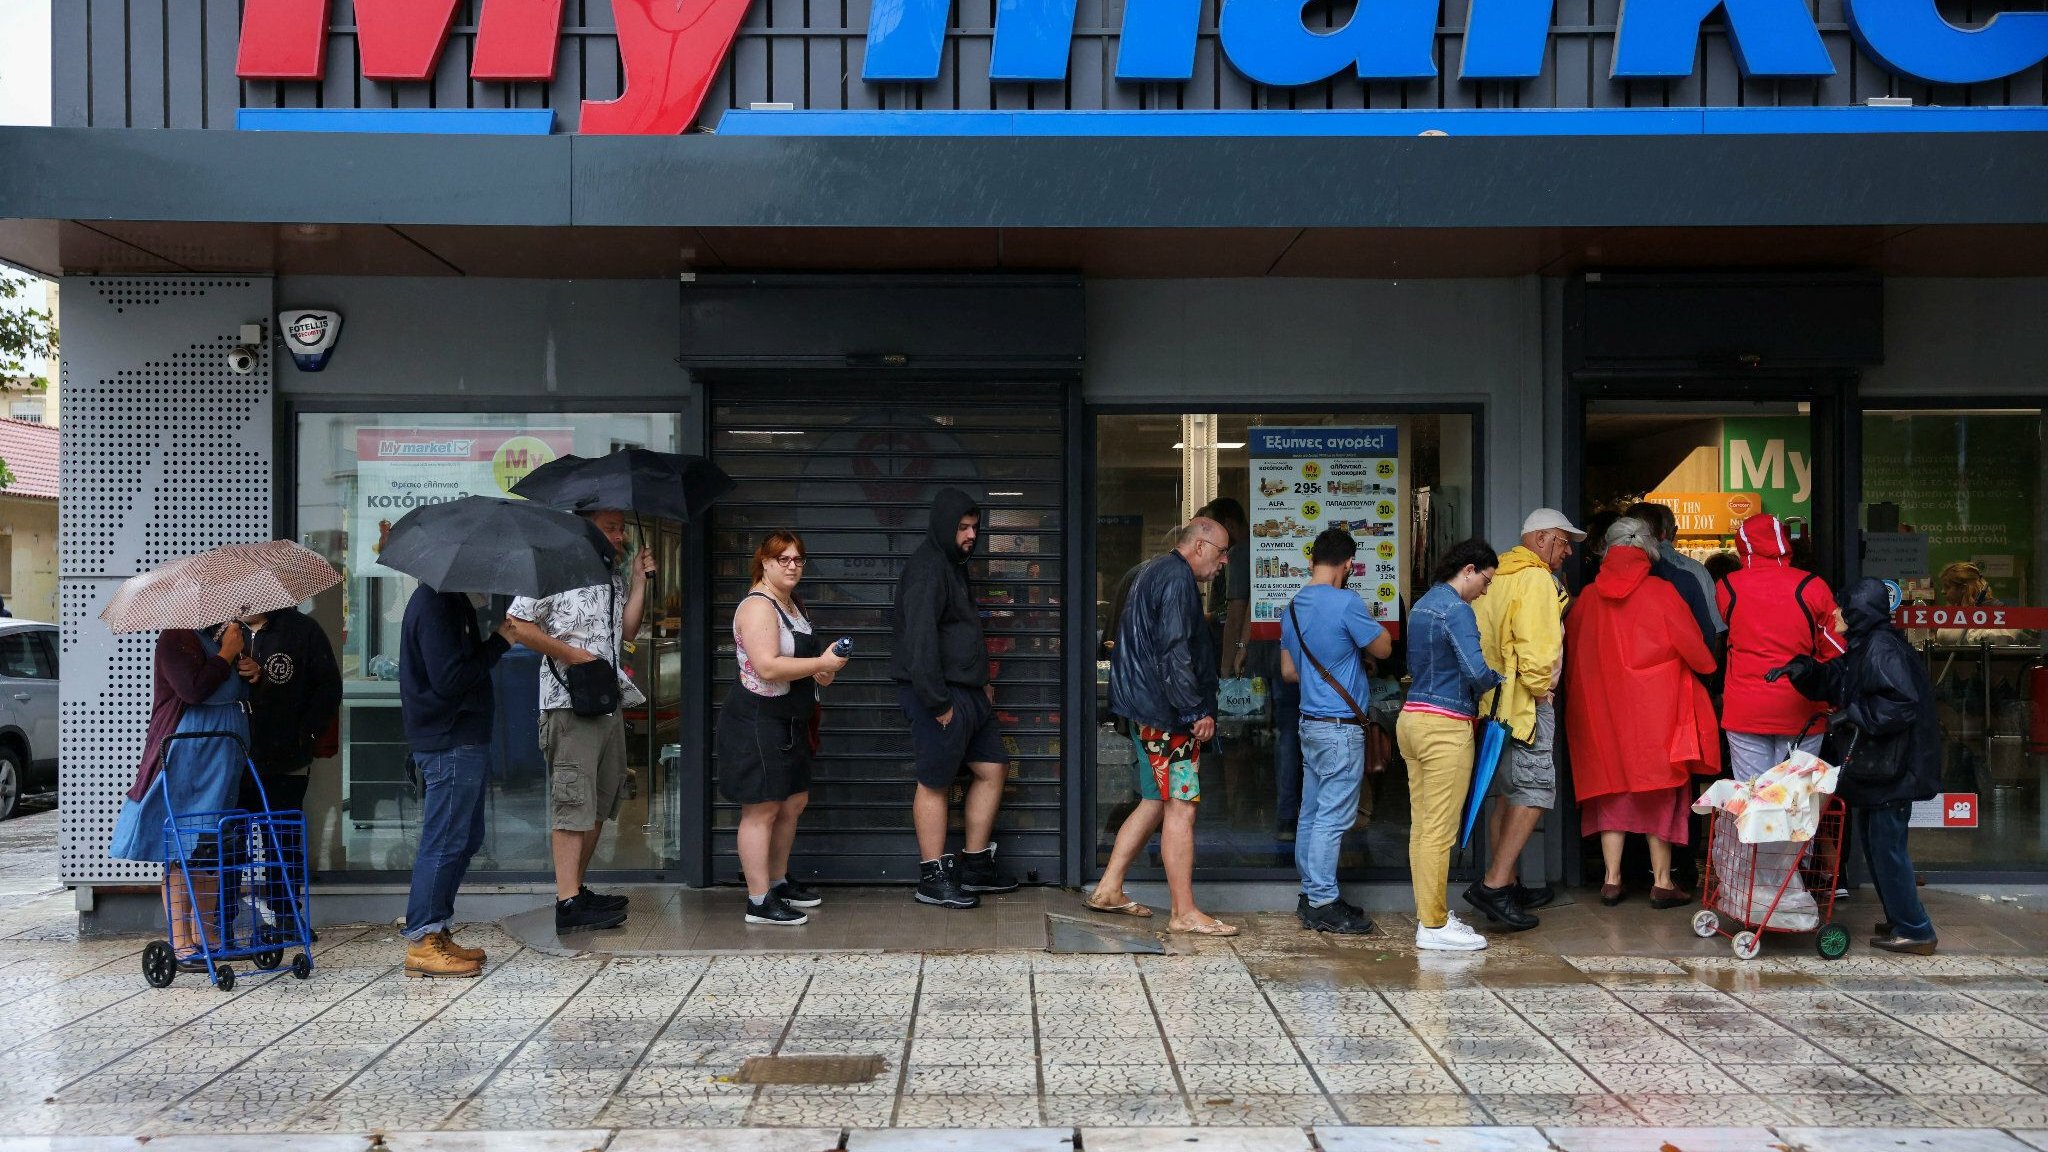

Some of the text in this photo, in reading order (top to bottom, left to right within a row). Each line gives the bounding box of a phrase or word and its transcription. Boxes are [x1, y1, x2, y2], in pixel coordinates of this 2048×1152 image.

[289, 320, 329, 333] FOTELLIS
[1327, 434, 1384, 449] αγορές!
[380, 441, 454, 455] My market
[1305, 465, 1318, 474] My
[1730, 439, 1811, 504] My
[1294, 482, 1322, 494] 2.95€
[1693, 514, 1715, 530] ΣΟΥ
[1928, 536, 1944, 545] ας
[1380, 544, 1393, 552] My
[274, 663, 285, 674] 72
